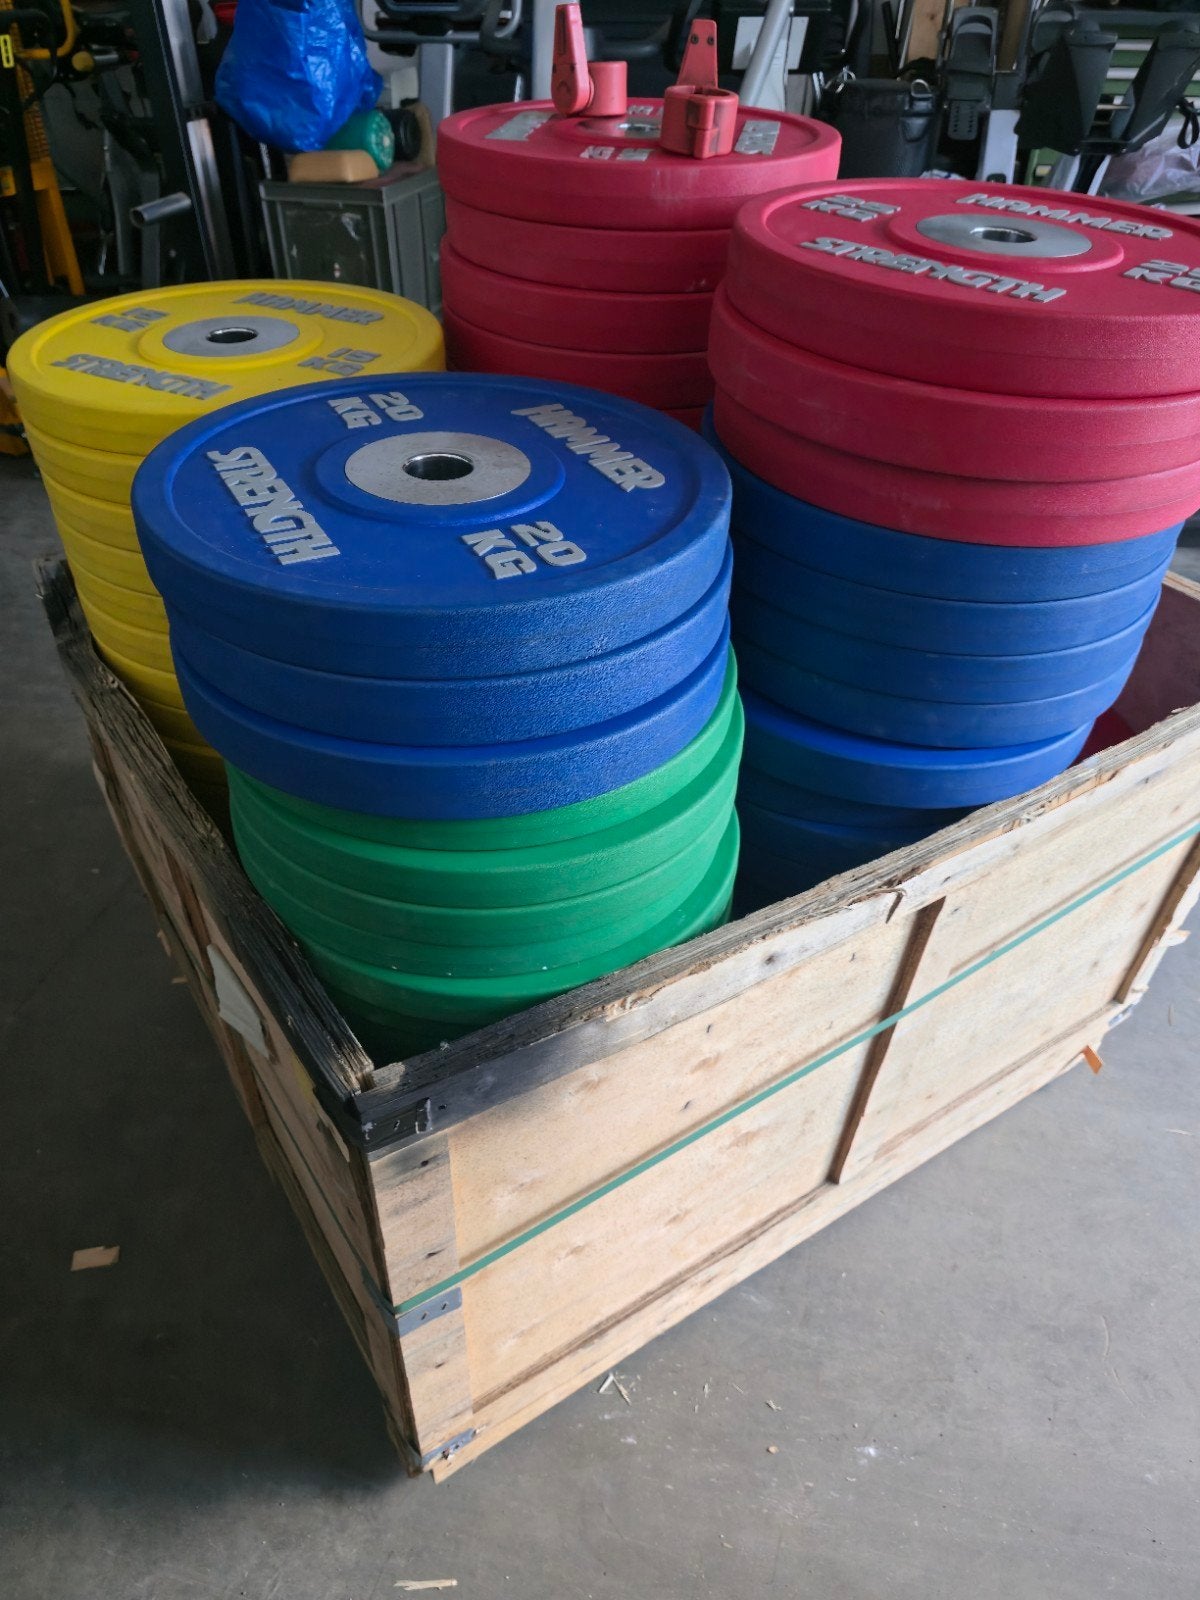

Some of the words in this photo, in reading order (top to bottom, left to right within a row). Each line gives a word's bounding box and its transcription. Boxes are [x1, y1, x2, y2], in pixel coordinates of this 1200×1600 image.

[801, 200, 879, 222] KG
[956, 193, 1173, 240] HAMMER
[800, 237, 1067, 304] STRENGTH
[233, 292, 385, 326] HAMMER
[51, 353, 234, 401] STRENGTH
[298, 356, 366, 377] KG
[328, 396, 382, 430] KG
[368, 391, 425, 422] 20
[510, 403, 666, 493] HAMMER
[206, 446, 341, 566] STRENGTH
[460, 528, 538, 580] KG
[510, 520, 588, 568] 20
